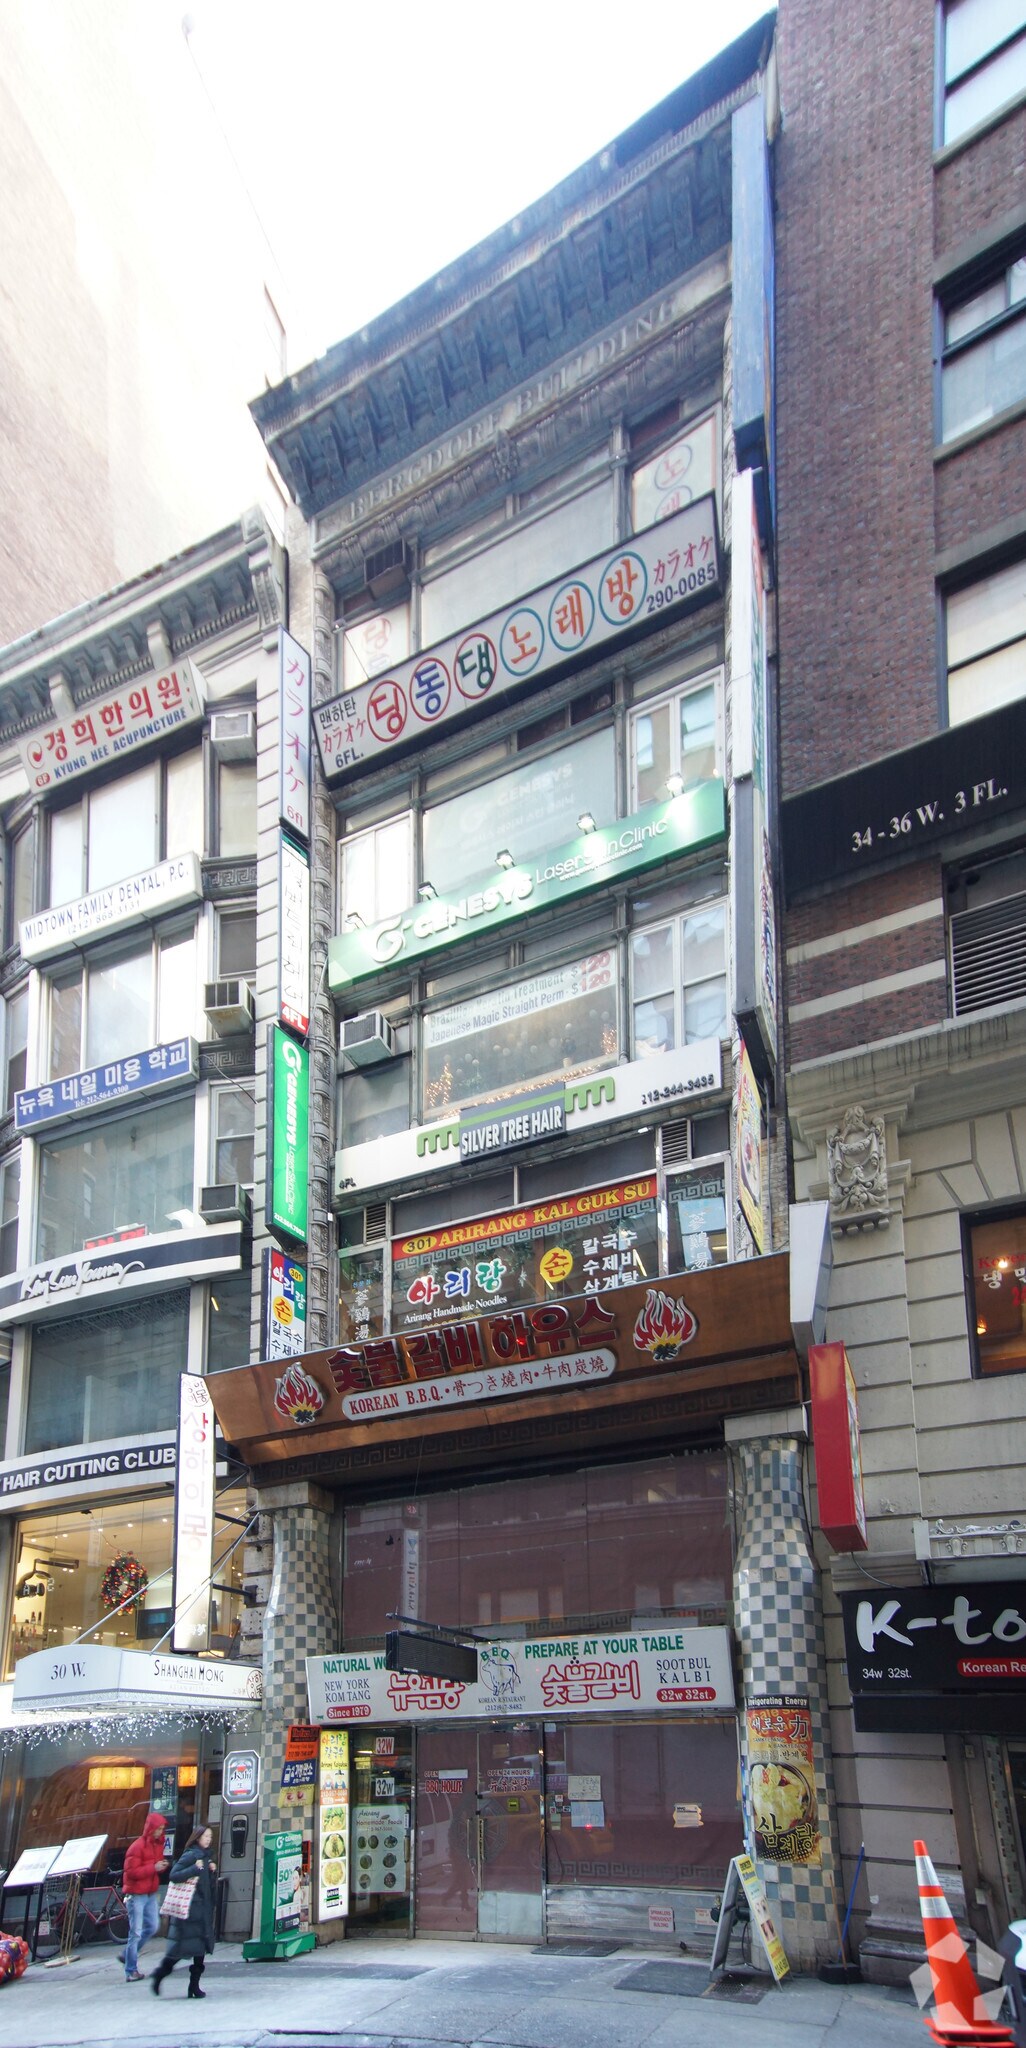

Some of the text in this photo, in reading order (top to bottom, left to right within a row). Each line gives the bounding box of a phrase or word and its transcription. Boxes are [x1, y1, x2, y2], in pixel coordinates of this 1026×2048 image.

[350, 300, 680, 520] BERGDORF BUILDING
[653, 535, 714, 585] カラオケ
[646, 562, 717, 614] 290-0085
[44, 672, 183, 761] 경희한의원
[285, 658, 305, 793] カラオケ
[320, 696, 357, 730] 맨하탄
[54, 707, 187, 779] KYUNG HEE ACUPUNCTURE
[323, 718, 366, 753] カラオケ
[335, 747, 364, 768] 6FL.
[36, 773, 50, 786] 6F
[916, 800, 944, 826] W.
[954, 790, 966, 814] 3
[972, 778, 1008, 807] FL.
[536, 853, 580, 884] Laser
[619, 818, 668, 849] Clinic
[25, 861, 190, 941] MIDTOWN FAMILY DENTAL, P.C.
[514, 971, 564, 999] Treatment
[281, 1006, 305, 1031] 4FL
[473, 1008, 500, 1030] Magic
[502, 995, 538, 1020] Straight
[541, 988, 564, 1007] Perm
[19, 1041, 188, 1116] 뉴욕 네일 미용 학교
[461, 1104, 563, 1157] SILVER TREE HAIR
[407, 1180, 651, 1254] 301 ARIRANG KAL GUK SU
[582, 1229, 638, 1257] 칼국수
[289, 1268, 303, 1281] 301
[582, 1251, 639, 1277] 수제비
[406, 1251, 570, 1305] 아리랑 손
[403, 1310, 432, 1326] Arirang
[433, 1302, 474, 1319] Handmade
[475, 1294, 507, 1312] Noodles
[271, 1319, 302, 1346] 칼국수
[489, 1296, 617, 1360] 하우스
[349, 1393, 400, 1416] KOREAN
[405, 1385, 444, 1406] B.B.Q.
[3, 1447, 176, 1492] HAIR CUTTING CLUB
[480, 1646, 509, 1661] BBQ
[525, 1635, 684, 1659] PREPARE AT YOUR TABLE
[51, 1661, 86, 1681] 30 W.
[154, 1660, 224, 1683] SHANGHAI MONG
[323, 1656, 371, 1674] NATURAL
[656, 1657, 711, 1671] SOOT BUL
[862, 1667, 912, 1679] 34w 32st.
[962, 1661, 1007, 1673] Korean
[325, 1678, 370, 1691] NEW YORK
[326, 1689, 371, 1703] KOM TANG
[661, 1688, 713, 1701] 32w 32st.
[328, 1706, 370, 1718] Since 1979
[748, 1696, 808, 1706] Invigorating Energy
[752, 1715, 785, 1732] 새로운
[376, 1738, 394, 1754] 32W
[231, 1768, 253, 1781] Asahi
[511, 1768, 531, 1776] HOURS
[425, 1780, 439, 1796] BBQ
[164, 1841, 172, 1850] A
[755, 1811, 816, 1858] 삼계탕
